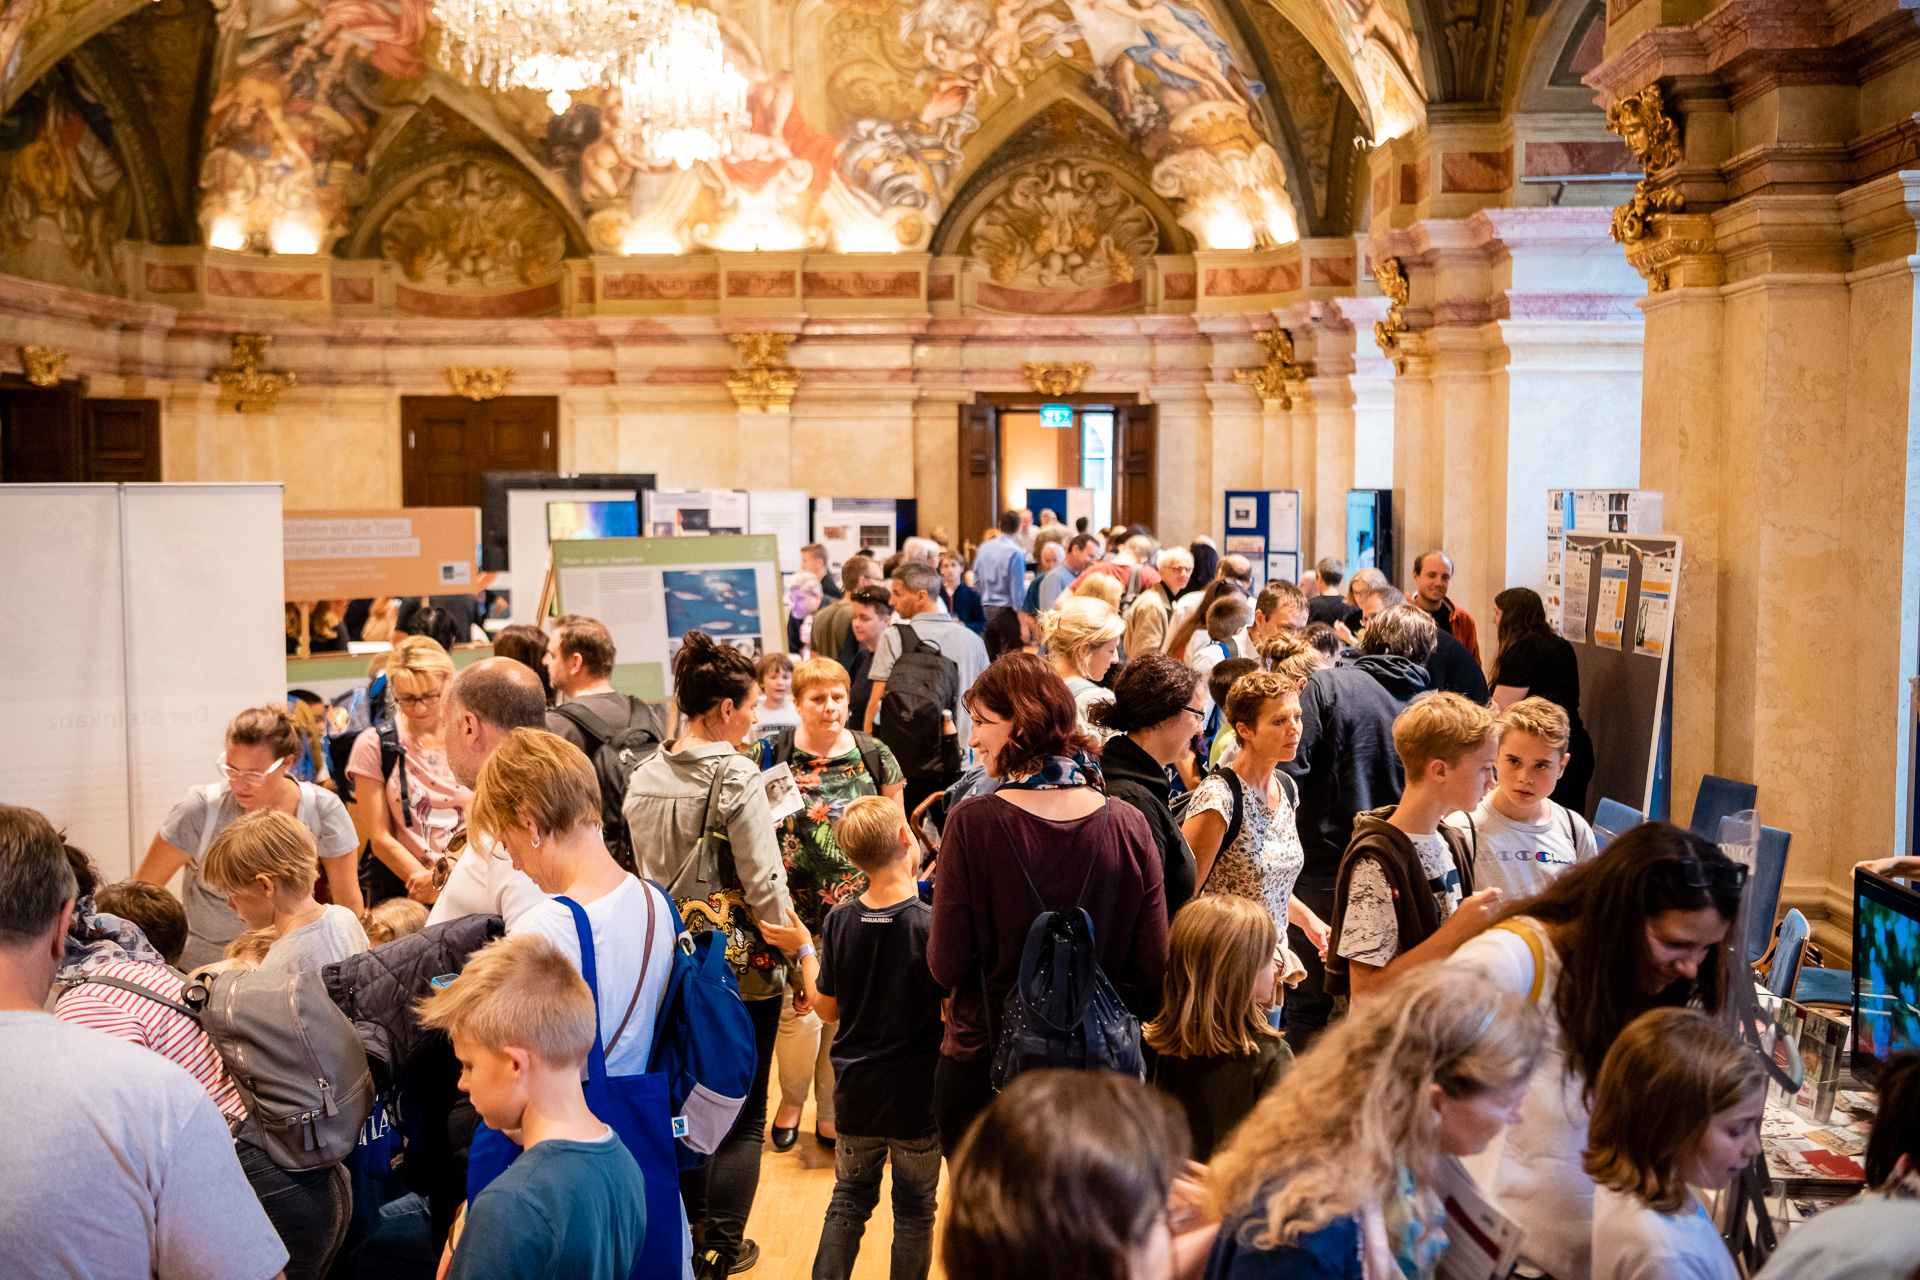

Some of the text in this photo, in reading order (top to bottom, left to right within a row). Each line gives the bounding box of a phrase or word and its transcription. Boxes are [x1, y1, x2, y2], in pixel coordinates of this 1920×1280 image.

[331, 523, 349, 534] wir
[352, 522, 371, 534] die
[374, 521, 409, 535] Tiere,
[330, 543, 347, 555] wir
[350, 544, 374, 554] uns
